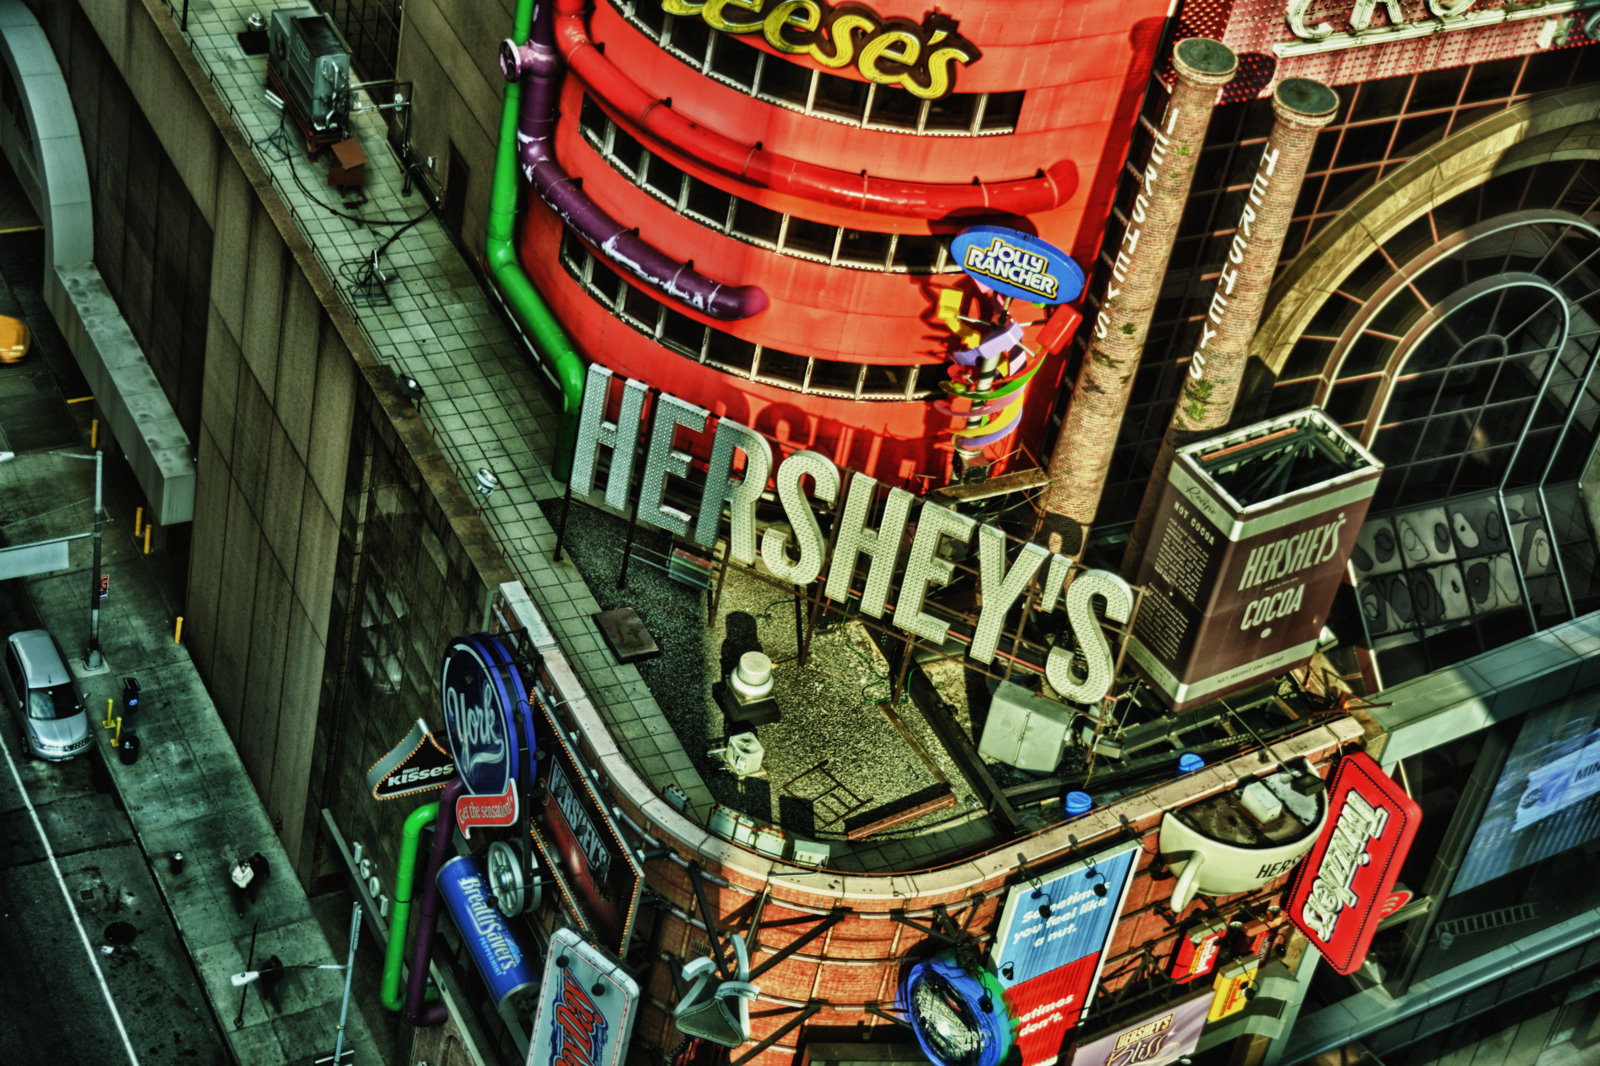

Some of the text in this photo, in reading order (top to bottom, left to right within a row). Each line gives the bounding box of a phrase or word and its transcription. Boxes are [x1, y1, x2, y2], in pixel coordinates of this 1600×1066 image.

[662, 0, 969, 99] eese's
[967, 248, 1055, 294] RANCHER
[987, 241, 1044, 273] JOLLY
[570, 362, 1134, 704] HERSHEY'S
[1190, 518, 1215, 546] COCOA
[1237, 513, 1347, 592] HERSHEY'S
[1240, 583, 1305, 631] COCOA
[447, 678, 505, 774] York
[469, 801, 480, 818] the
[1302, 789, 1389, 942] Twizzlers
[1013, 897, 1108, 944] you feel like
[1022, 882, 1110, 924] Soetims
[1034, 923, 1077, 948] a nut.
[1018, 994, 1074, 1023] etimes
[1019, 1012, 1063, 1037] don't.
